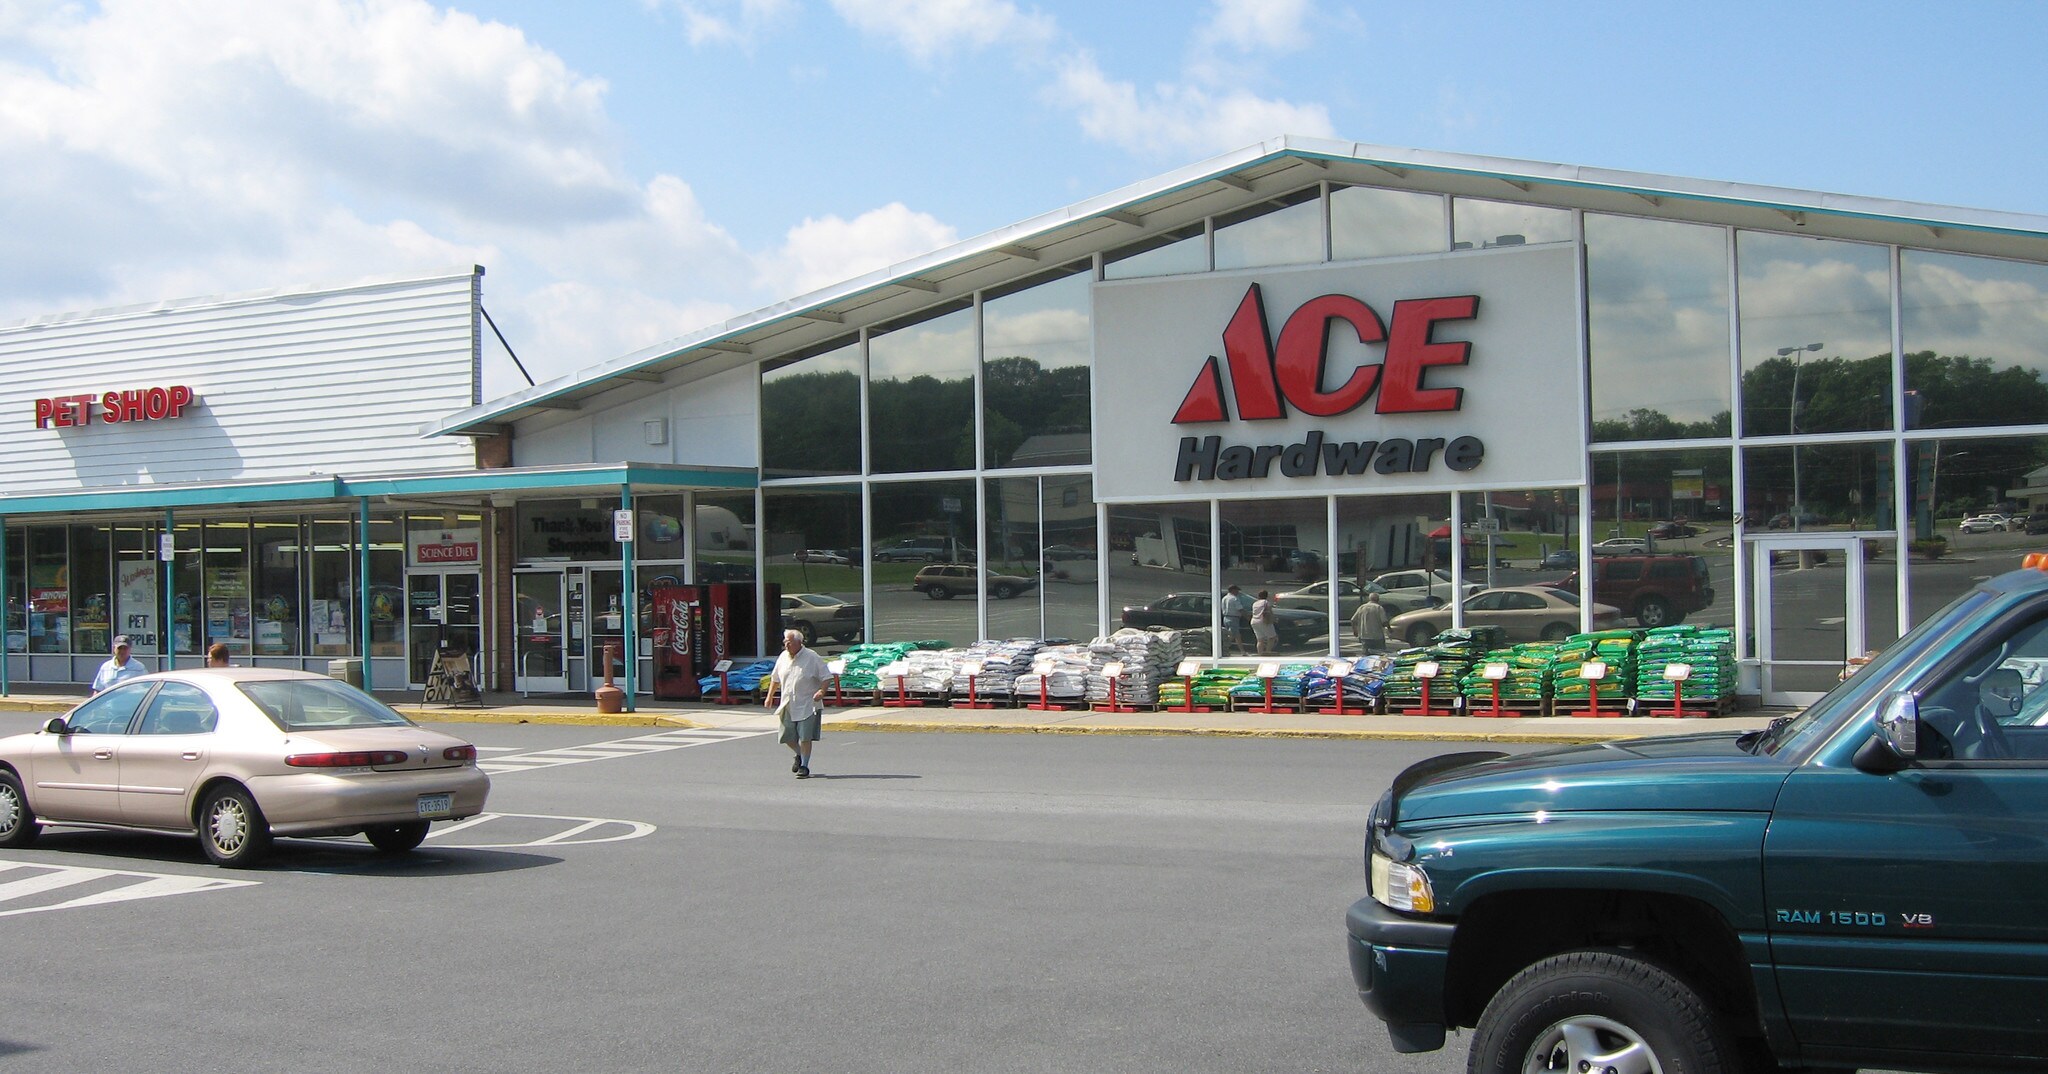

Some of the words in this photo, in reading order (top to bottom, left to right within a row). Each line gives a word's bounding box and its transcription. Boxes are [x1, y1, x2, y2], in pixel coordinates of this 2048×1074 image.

[1170, 282, 1480, 424] ACE
[36, 394, 95, 428] PET
[102, 385, 193, 424] SHOP
[1174, 430, 1485, 482] Hardware
[531, 517, 574, 533] Thank
[577, 517, 602, 533] You
[421, 546, 454, 559] SCIENCE
[455, 545, 475, 558] DIET
[548, 537, 611, 555] Shopping
[128, 614, 150, 629] PET
[1776, 909, 1821, 924] RAM
[1829, 911, 1887, 926] 1500
[1901, 912, 1933, 925] V8
